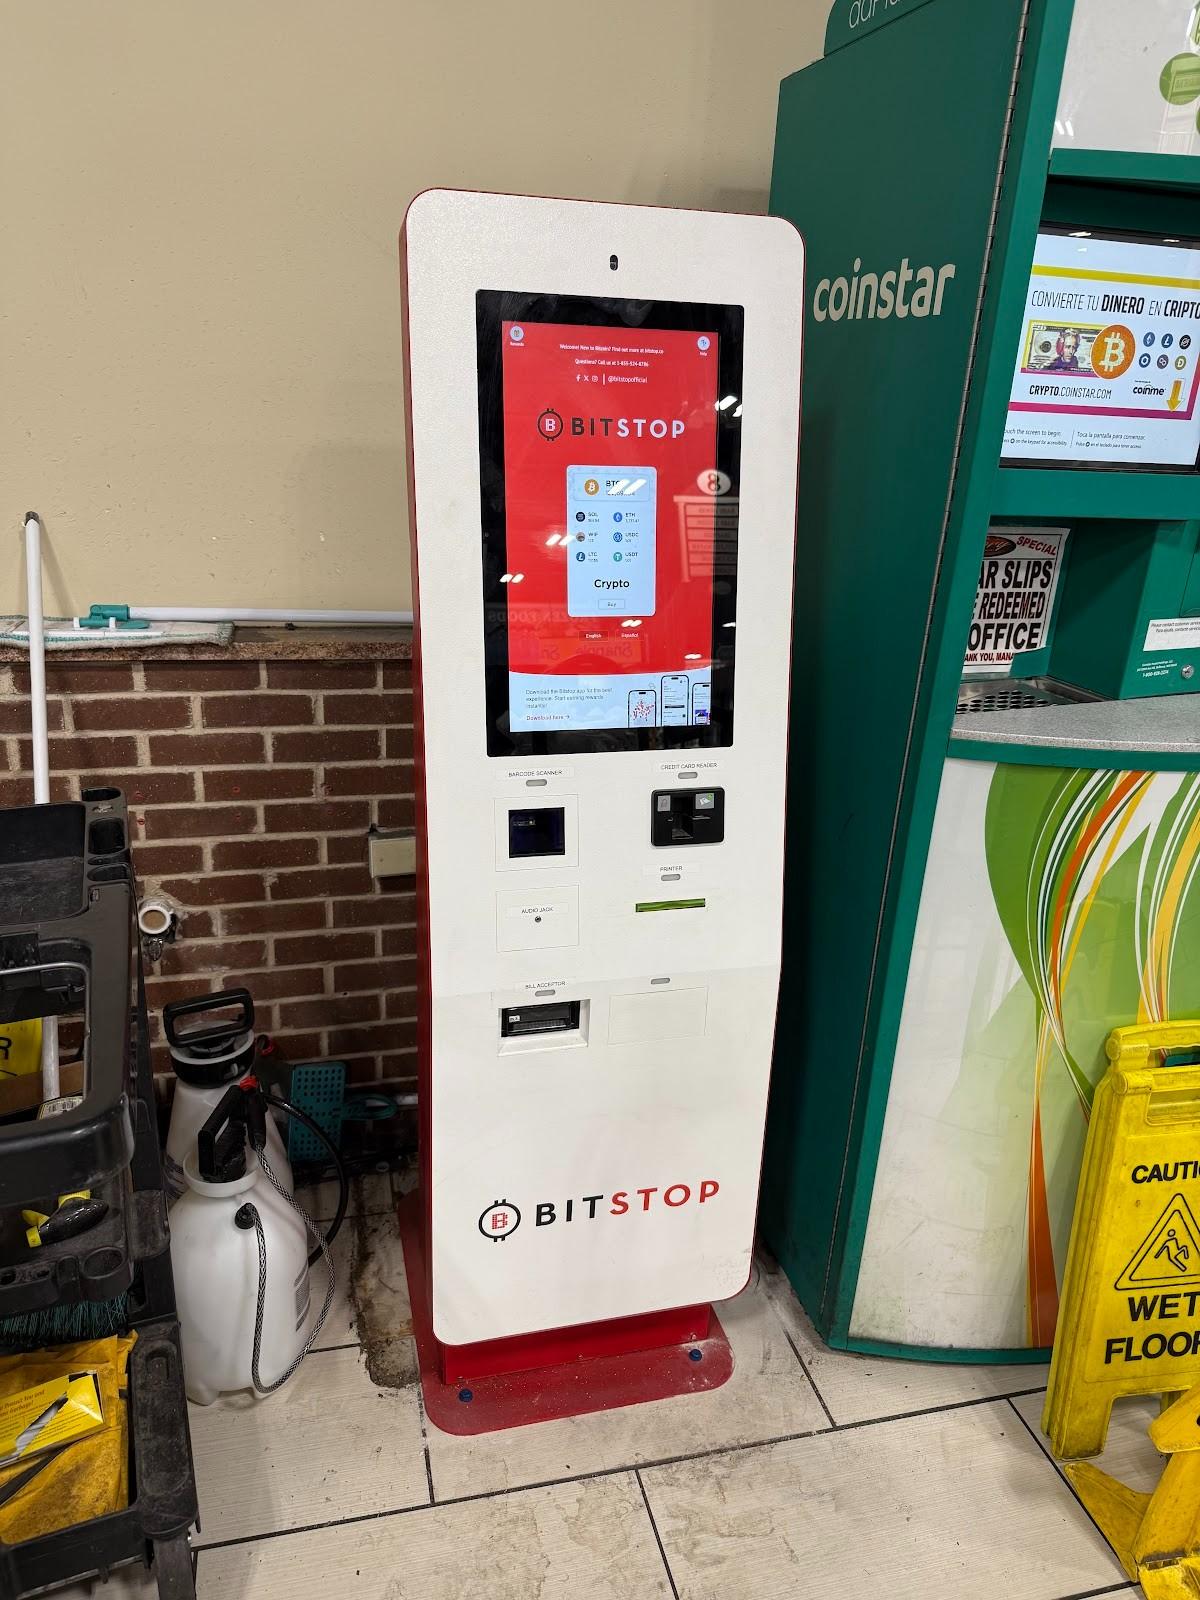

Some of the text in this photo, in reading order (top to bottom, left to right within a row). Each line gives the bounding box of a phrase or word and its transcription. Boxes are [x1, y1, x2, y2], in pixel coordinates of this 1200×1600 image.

[813, 257, 956, 322] coinstar
[1031, 290, 1200, 320] CONVIERTE TU DINERO EN CRIPTO
[1029, 384, 1112, 399] CRYPTO.COINSTAR.COM
[1133, 385, 1165, 396] coinme
[571, 417, 685, 438] BITSTOP
[1016, 536, 1057, 556] SPECIAL
[594, 579, 630, 590] Crypto
[1002, 560, 1053, 589] SLIPS
[978, 592, 1046, 620] REDEEMED
[967, 622, 1042, 651] OFFICE
[979, 652, 994, 663] YOU,
[535, 1180, 720, 1227] BITSTOP
[1128, 1291, 1200, 1322] WET
